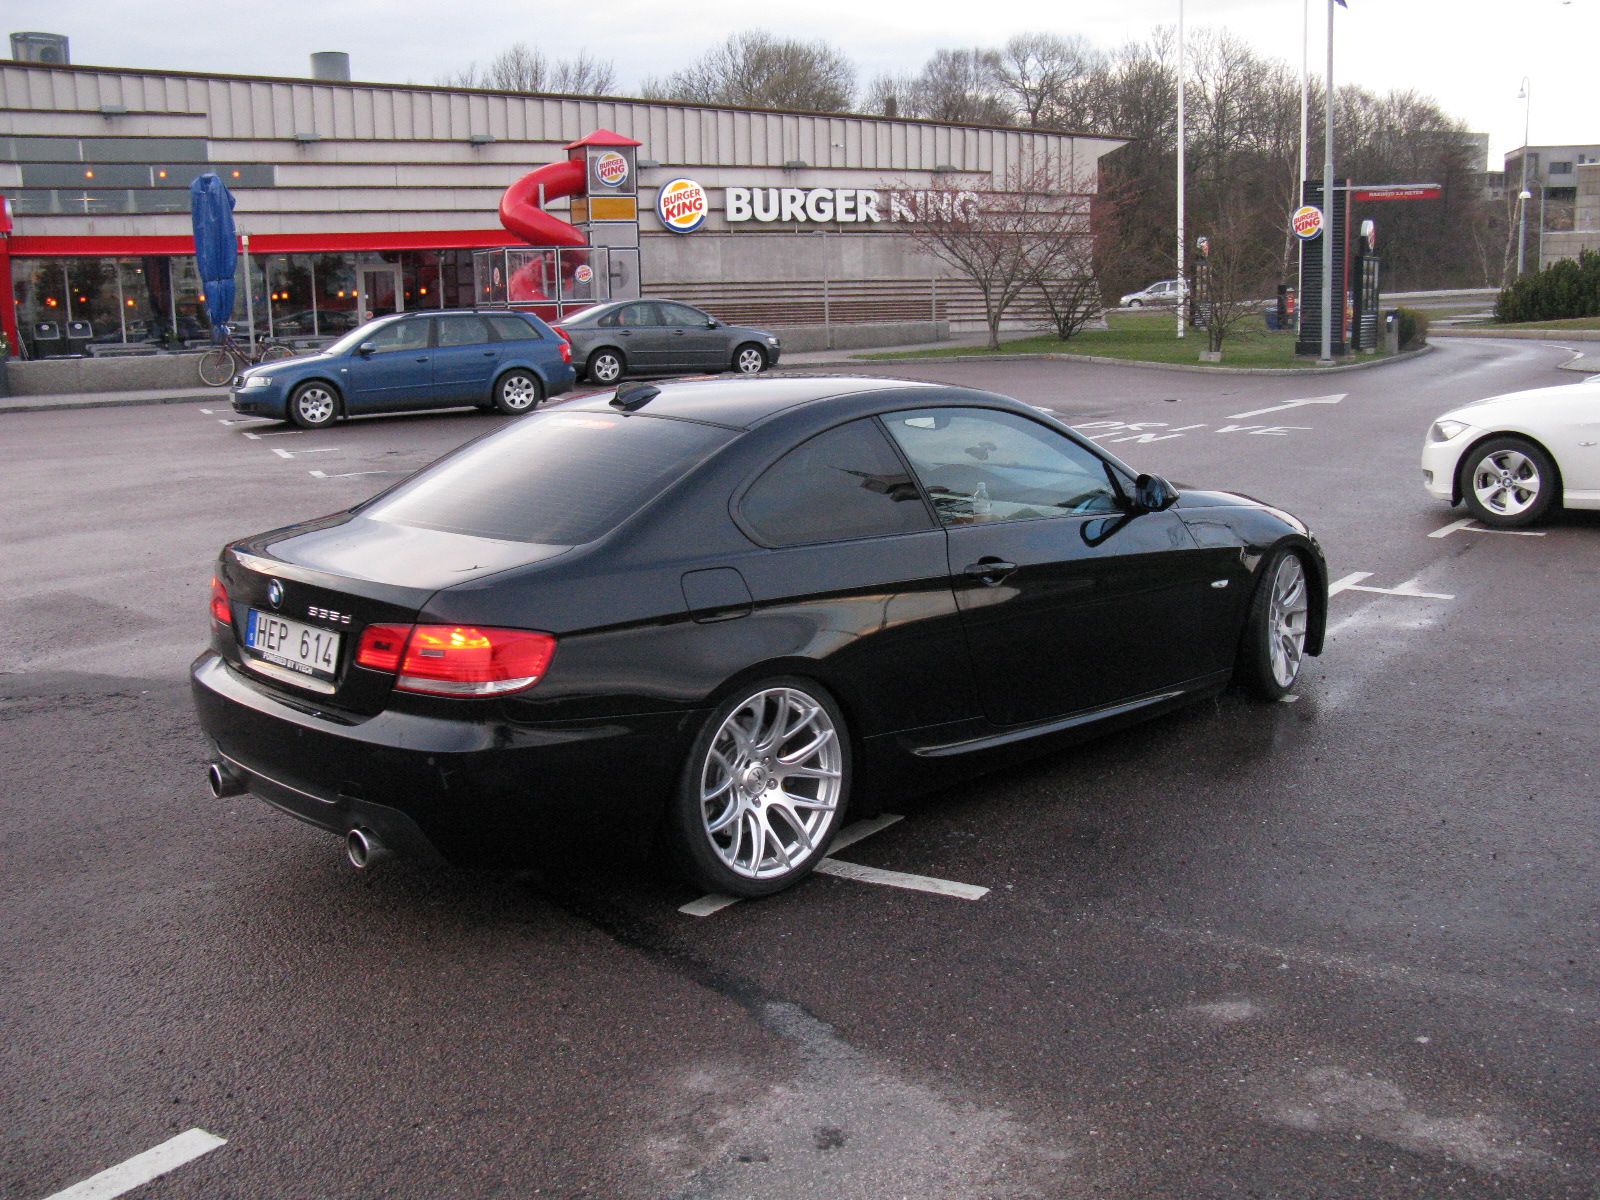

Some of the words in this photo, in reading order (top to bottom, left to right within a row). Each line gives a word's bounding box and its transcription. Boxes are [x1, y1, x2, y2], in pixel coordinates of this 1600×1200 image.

[600, 159, 624, 170] BURGER
[600, 165, 625, 178] KING
[663, 188, 701, 208] BURGER
[725, 187, 881, 222] BURGER
[890, 190, 979, 223] KING
[665, 197, 703, 222] KING
[1293, 211, 1319, 225] BURGER
[1295, 217, 1320, 233] KING
[1071, 421, 1313, 436] DRIVE
[257, 616, 288, 651] HEP
[300, 629, 333, 667] 614
